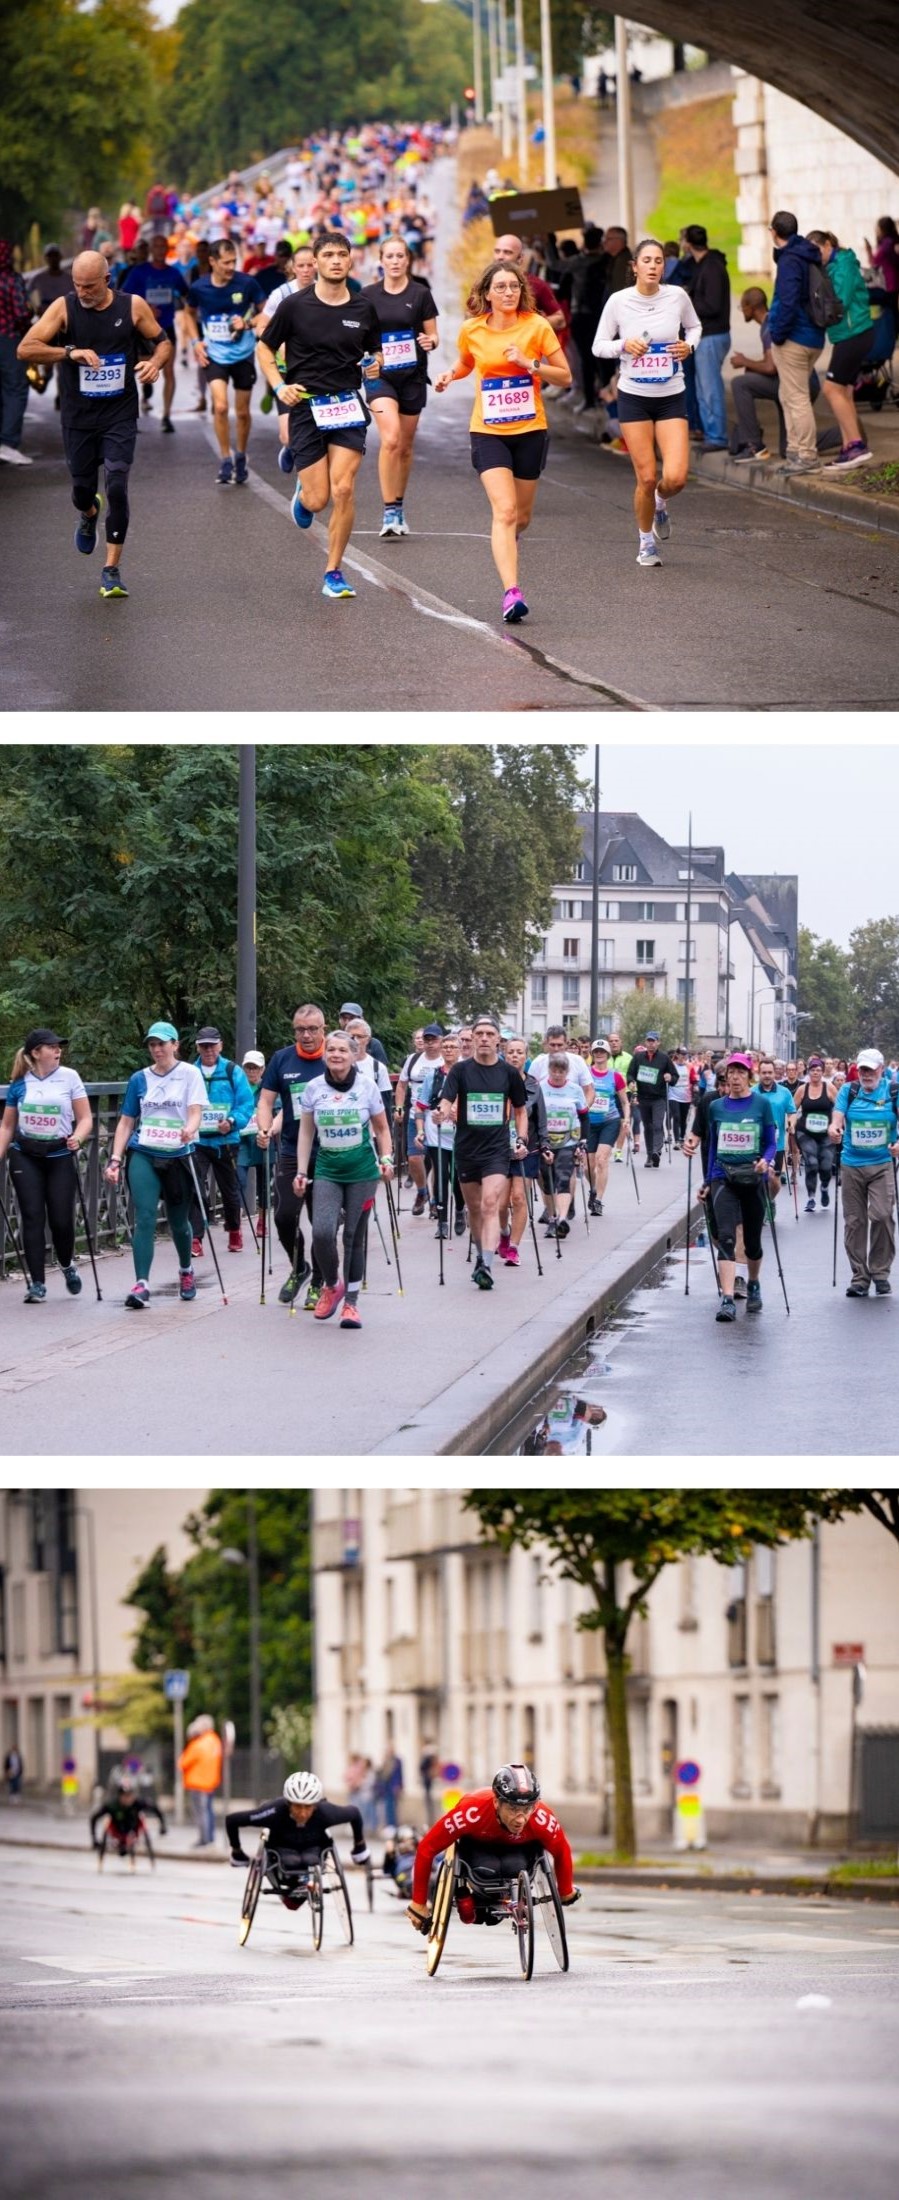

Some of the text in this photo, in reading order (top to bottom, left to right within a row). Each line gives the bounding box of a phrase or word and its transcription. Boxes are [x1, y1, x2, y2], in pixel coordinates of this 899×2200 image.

[632, 357, 668, 368] 21212
[84, 368, 121, 381] 22393
[488, 391, 529, 406] 21689
[318, 402, 356, 418] 23250
[471, 1104, 500, 1113] 15311
[24, 1115, 56, 1127] 15250
[146, 1128, 179, 1139] 15249
[323, 1127, 357, 1139] 15443
[722, 1133, 750, 1143] 15361
[855, 1130, 883, 1139] 15357
[444, 1806, 481, 1834] SEC
